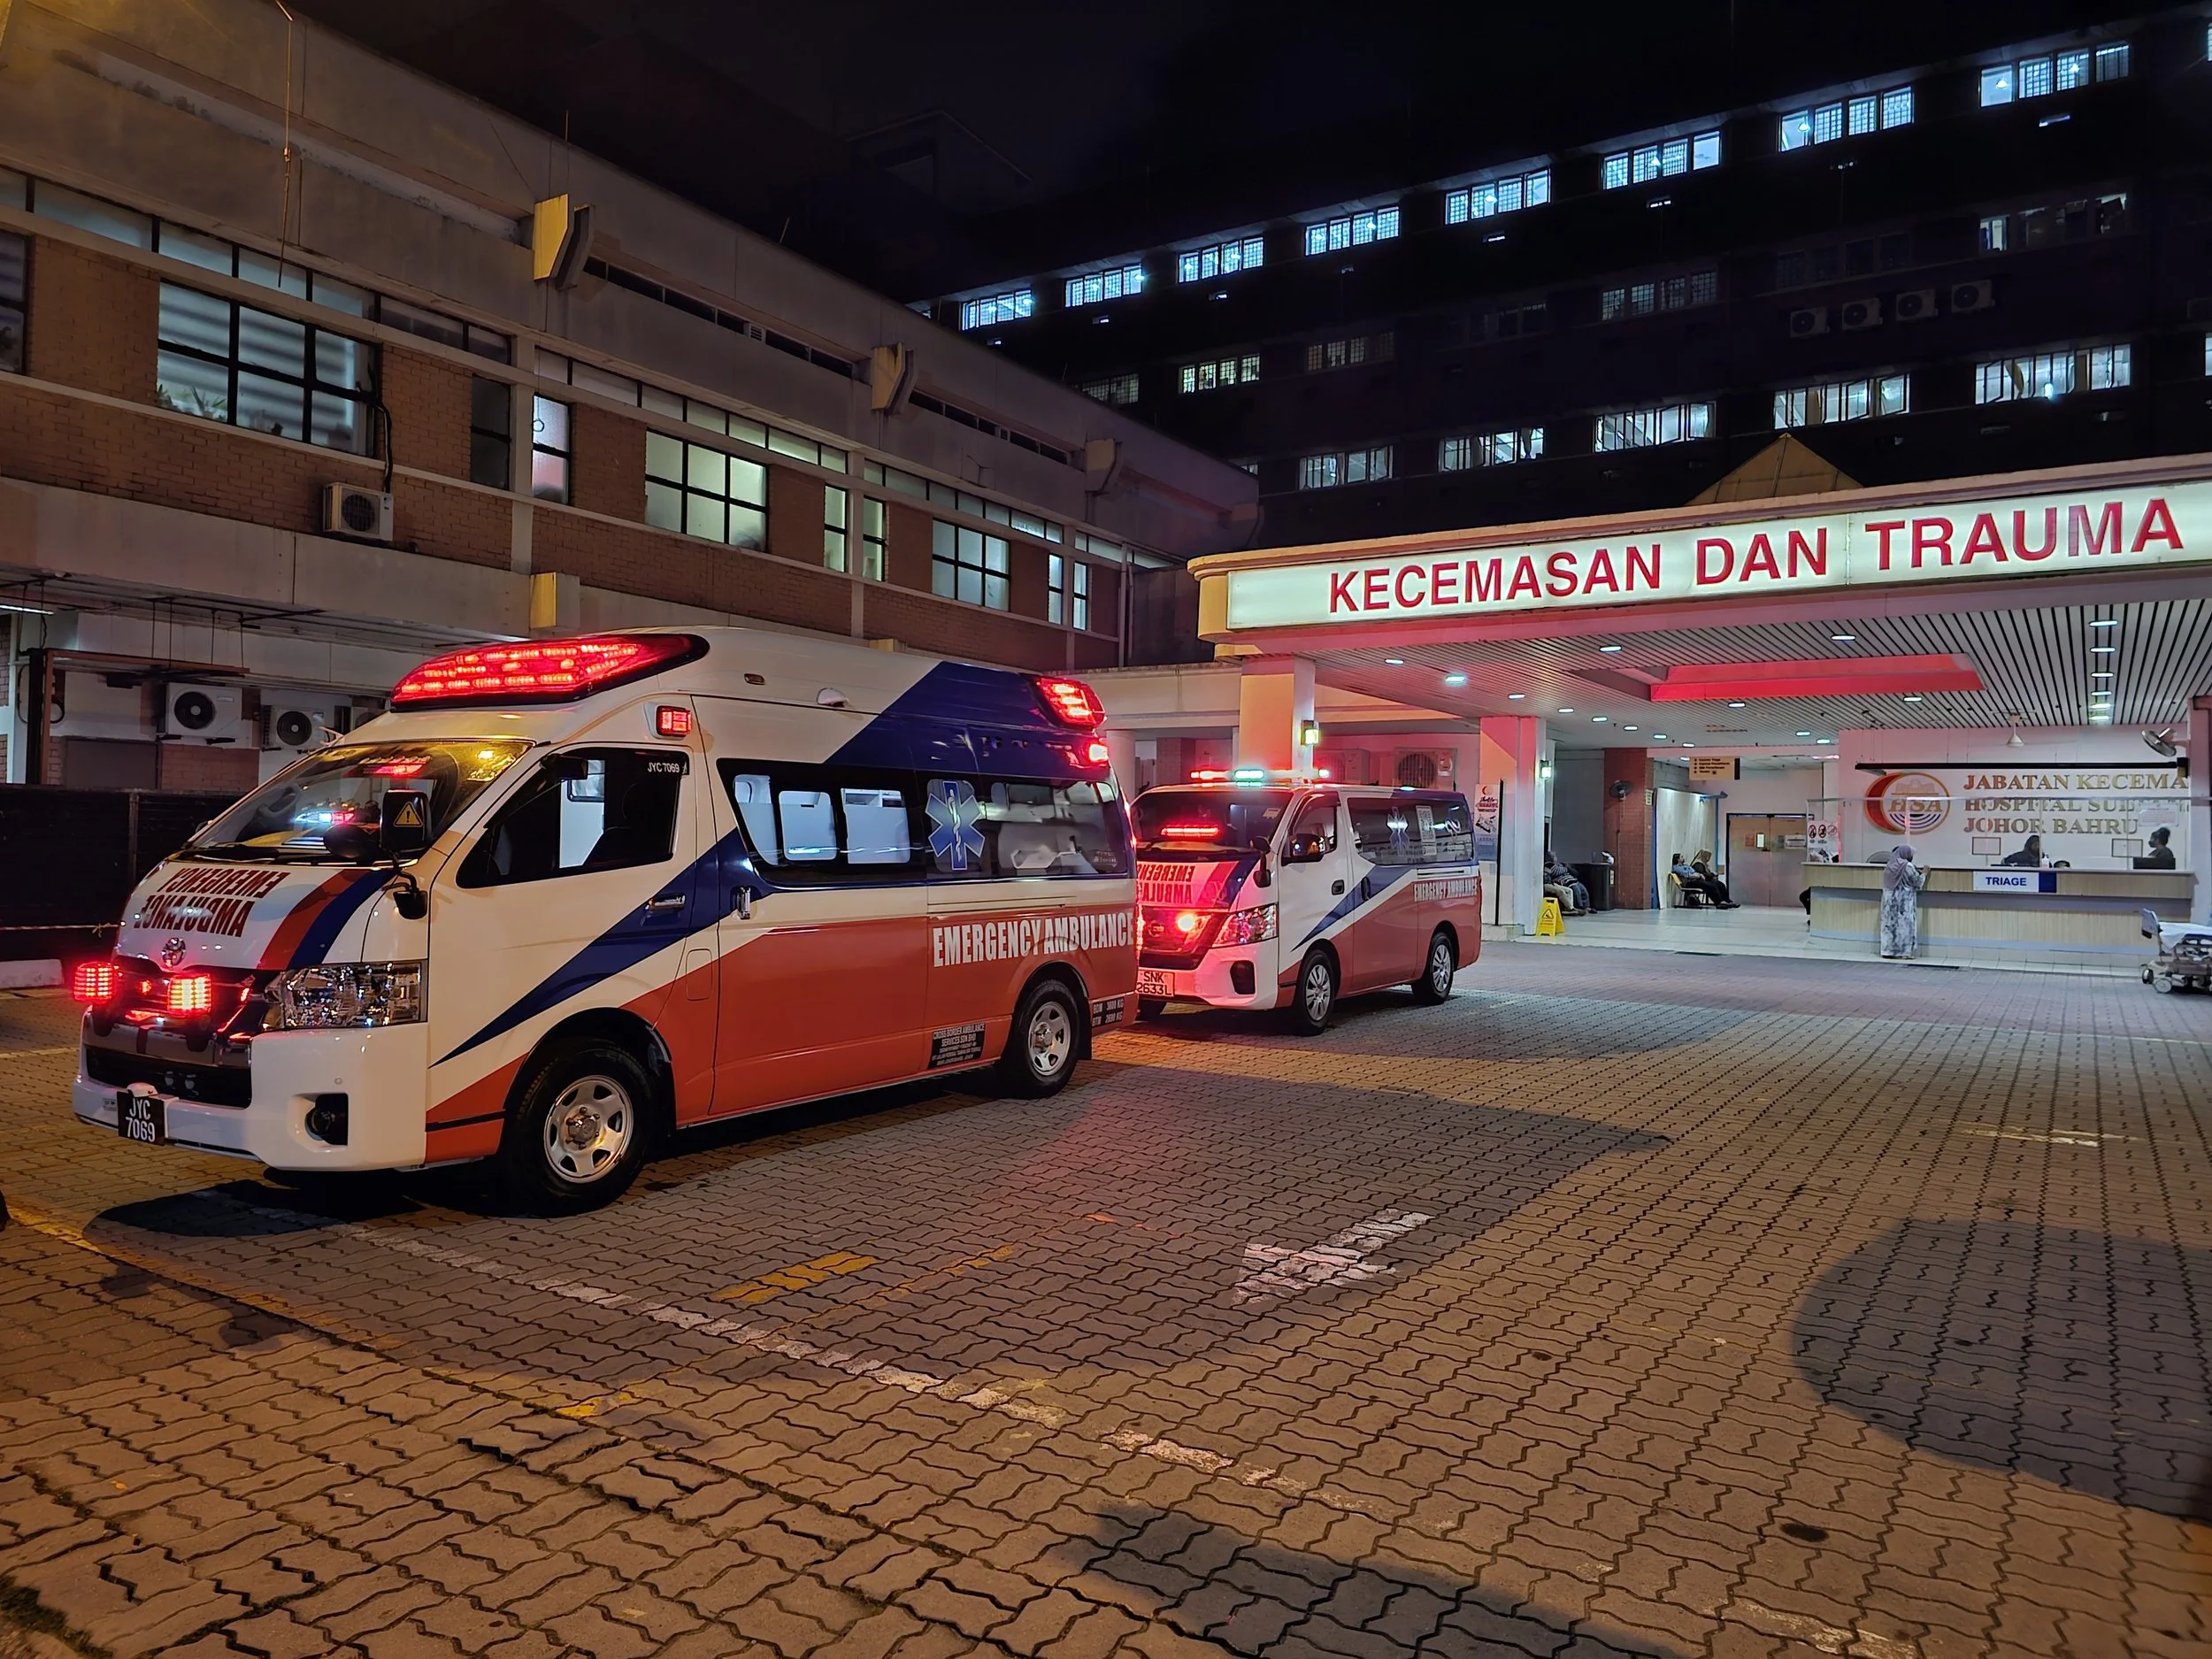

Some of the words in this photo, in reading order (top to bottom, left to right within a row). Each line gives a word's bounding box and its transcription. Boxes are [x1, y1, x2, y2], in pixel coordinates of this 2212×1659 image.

[1329, 545, 1661, 613] KECEMASAN
[1695, 528, 1827, 585] DAN
[1865, 497, 2184, 570] TRAUMA
[648, 762, 662, 772] JYC
[662, 763, 680, 773] 7069
[1963, 774, 2070, 790] JABATAN
[1963, 817, 2047, 833] JOHOR
[2053, 818, 2138, 834] BAHRU
[1985, 877, 2027, 887] TRIAGE
[1414, 880, 1448, 902] EMERGENCY
[933, 918, 1041, 967] EMERGENCY
[1043, 911, 1133, 955] AMBULANCE
[1143, 971, 1164, 984] SNK
[1136, 982, 1172, 996] 2633L
[129, 1097, 151, 1120] JYC
[125, 1116, 156, 1143] 7069
